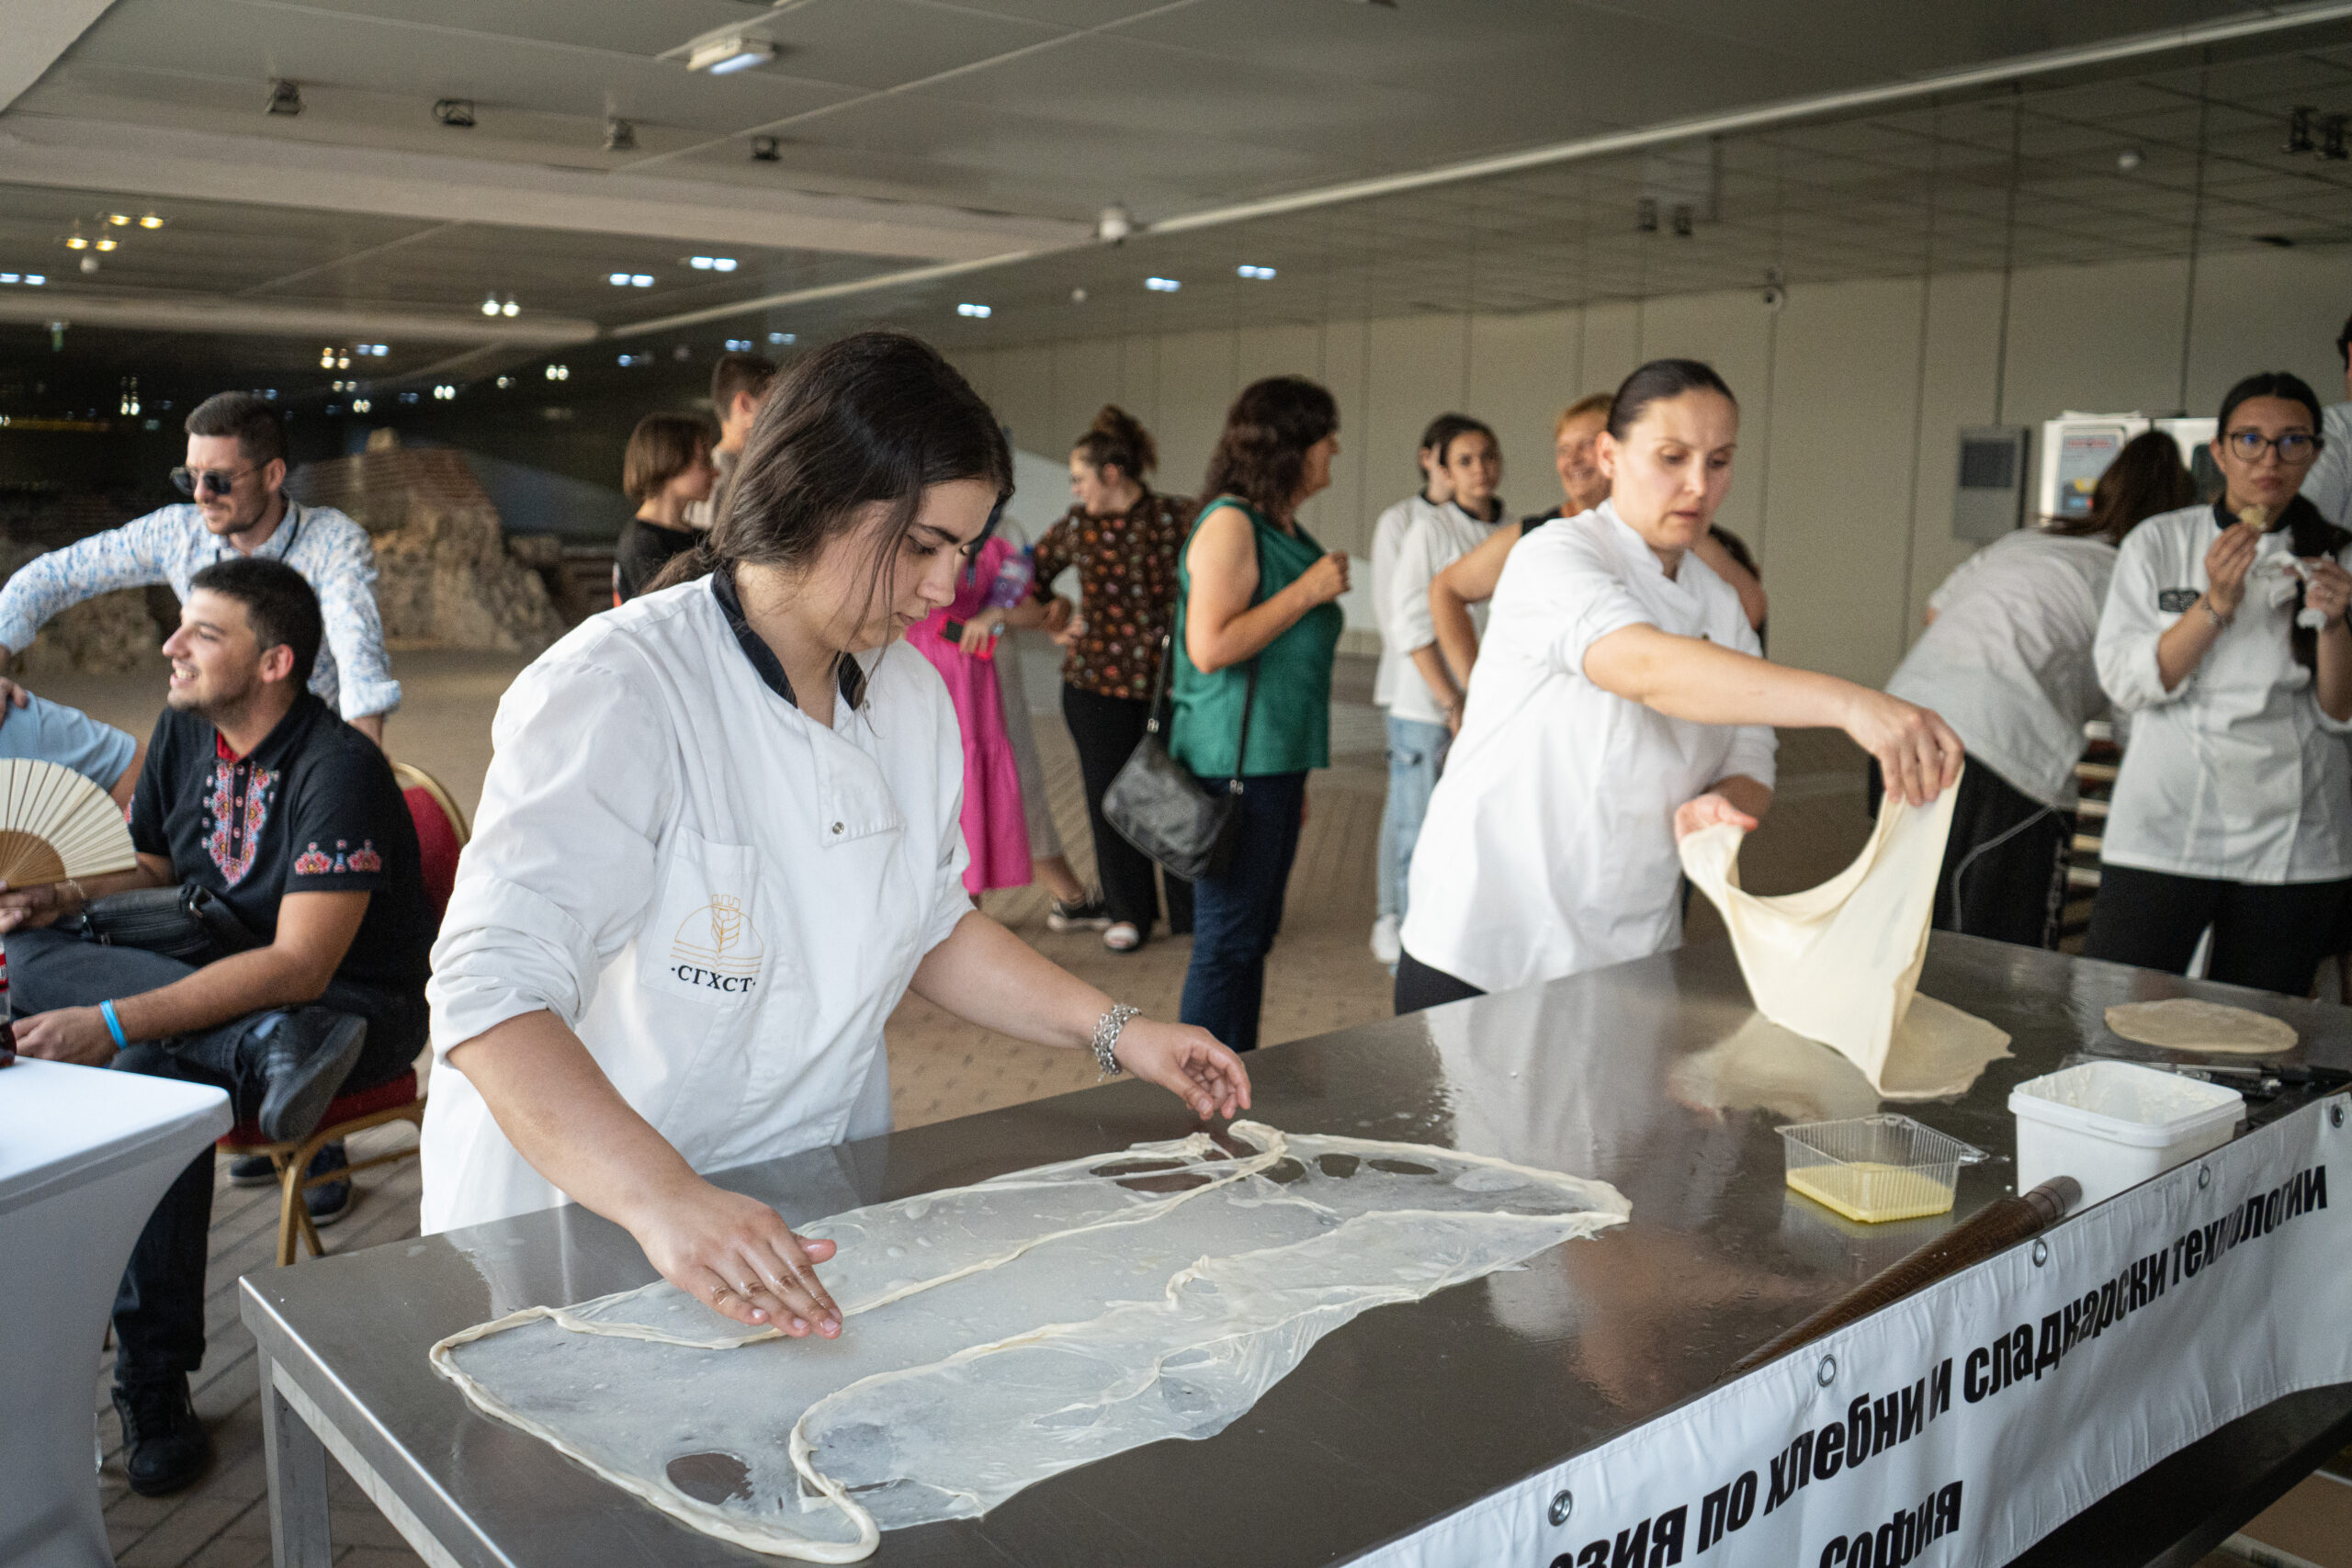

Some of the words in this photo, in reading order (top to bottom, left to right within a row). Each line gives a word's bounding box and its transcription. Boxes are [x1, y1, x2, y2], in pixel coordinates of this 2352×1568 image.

[1697, 1470, 1758, 1555] по
[1763, 1376, 1926, 1517] хлебни
[1928, 1357, 1953, 1424] и
[1962, 1247, 2169, 1404] сладкарски
[2172, 1164, 2328, 1287] технологии
